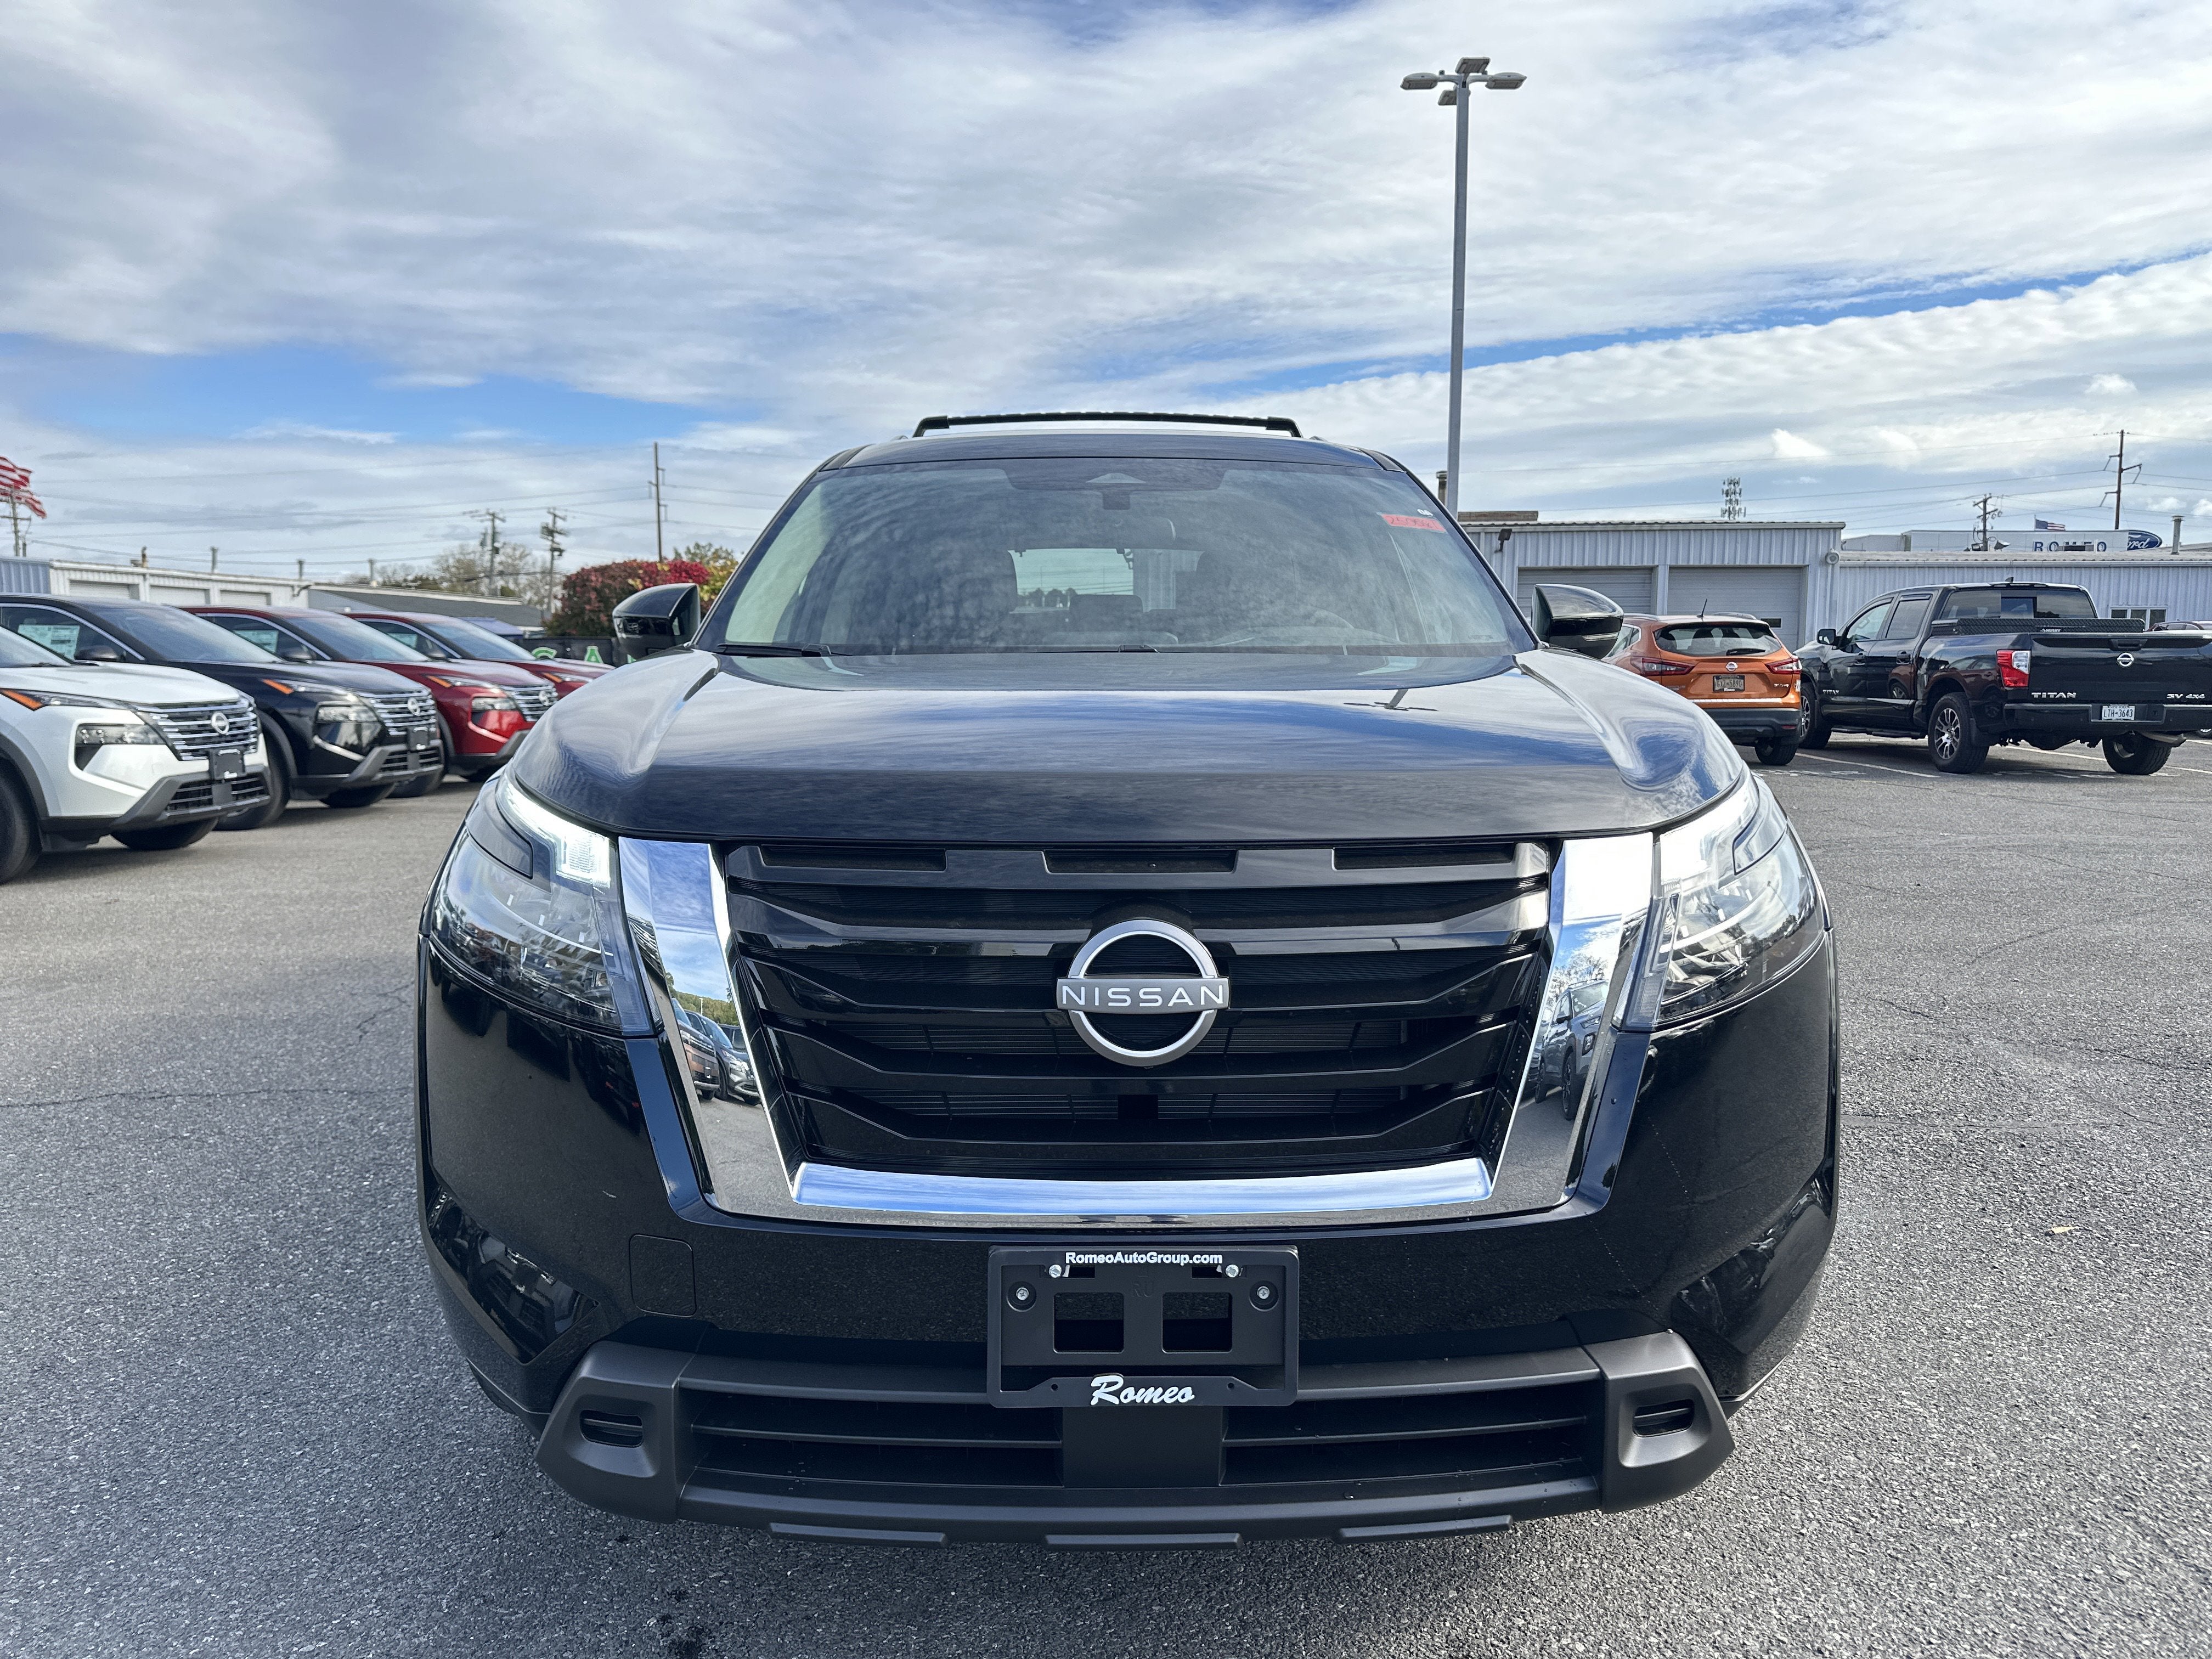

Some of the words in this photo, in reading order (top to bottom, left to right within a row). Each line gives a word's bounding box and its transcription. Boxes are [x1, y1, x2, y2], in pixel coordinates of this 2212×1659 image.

[1062, 985, 1223, 1007] NISSAN
[1065, 1252, 1222, 1266] RomeoAutoGroup.com
[1091, 1375, 1195, 1405] Romeo
